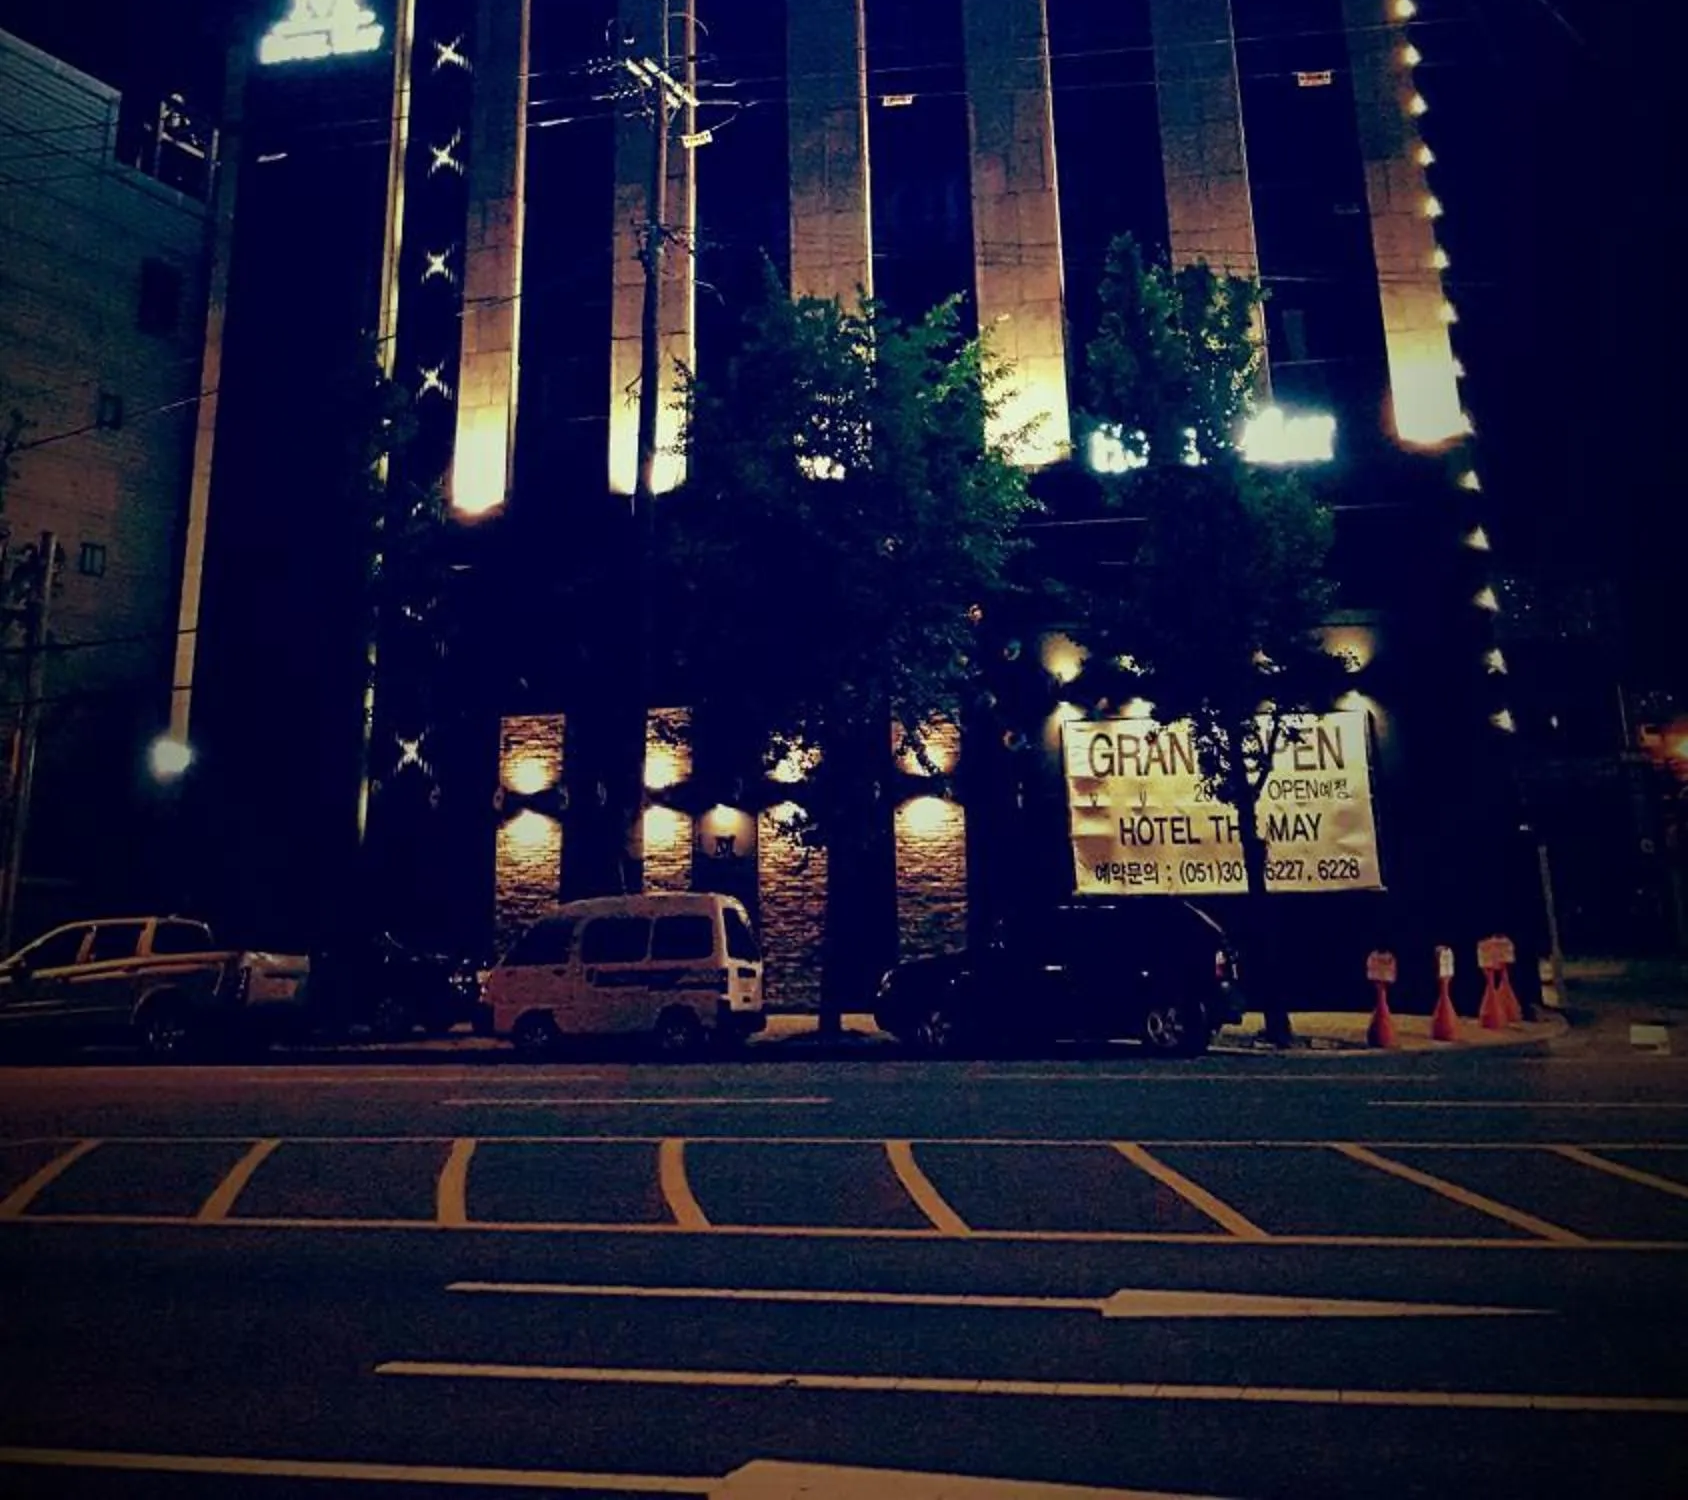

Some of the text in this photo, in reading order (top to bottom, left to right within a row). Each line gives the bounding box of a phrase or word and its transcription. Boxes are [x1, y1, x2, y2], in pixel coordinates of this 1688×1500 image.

[1088, 730, 1198, 777] GRAN
[1119, 812, 1322, 846] HOTEL TH MAY
[1095, 860, 1159, 885] 예약문의
